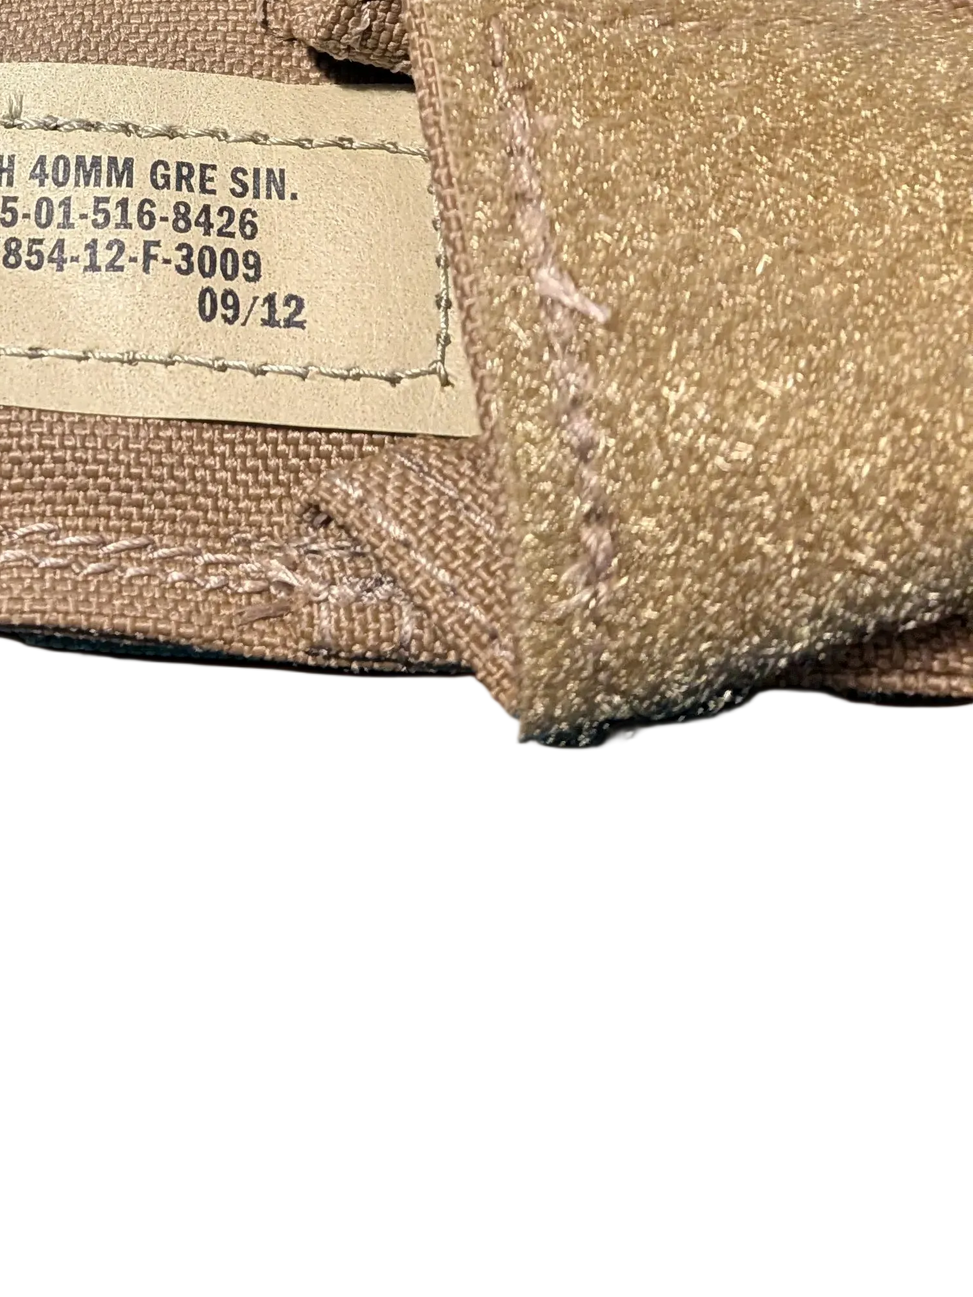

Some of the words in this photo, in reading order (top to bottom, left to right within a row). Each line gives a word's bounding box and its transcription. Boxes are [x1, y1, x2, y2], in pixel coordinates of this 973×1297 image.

[28, 154, 134, 189] 40MM
[149, 159, 217, 195] GRE
[229, 166, 298, 201] SIN.
[197, 286, 307, 329] 09/12
